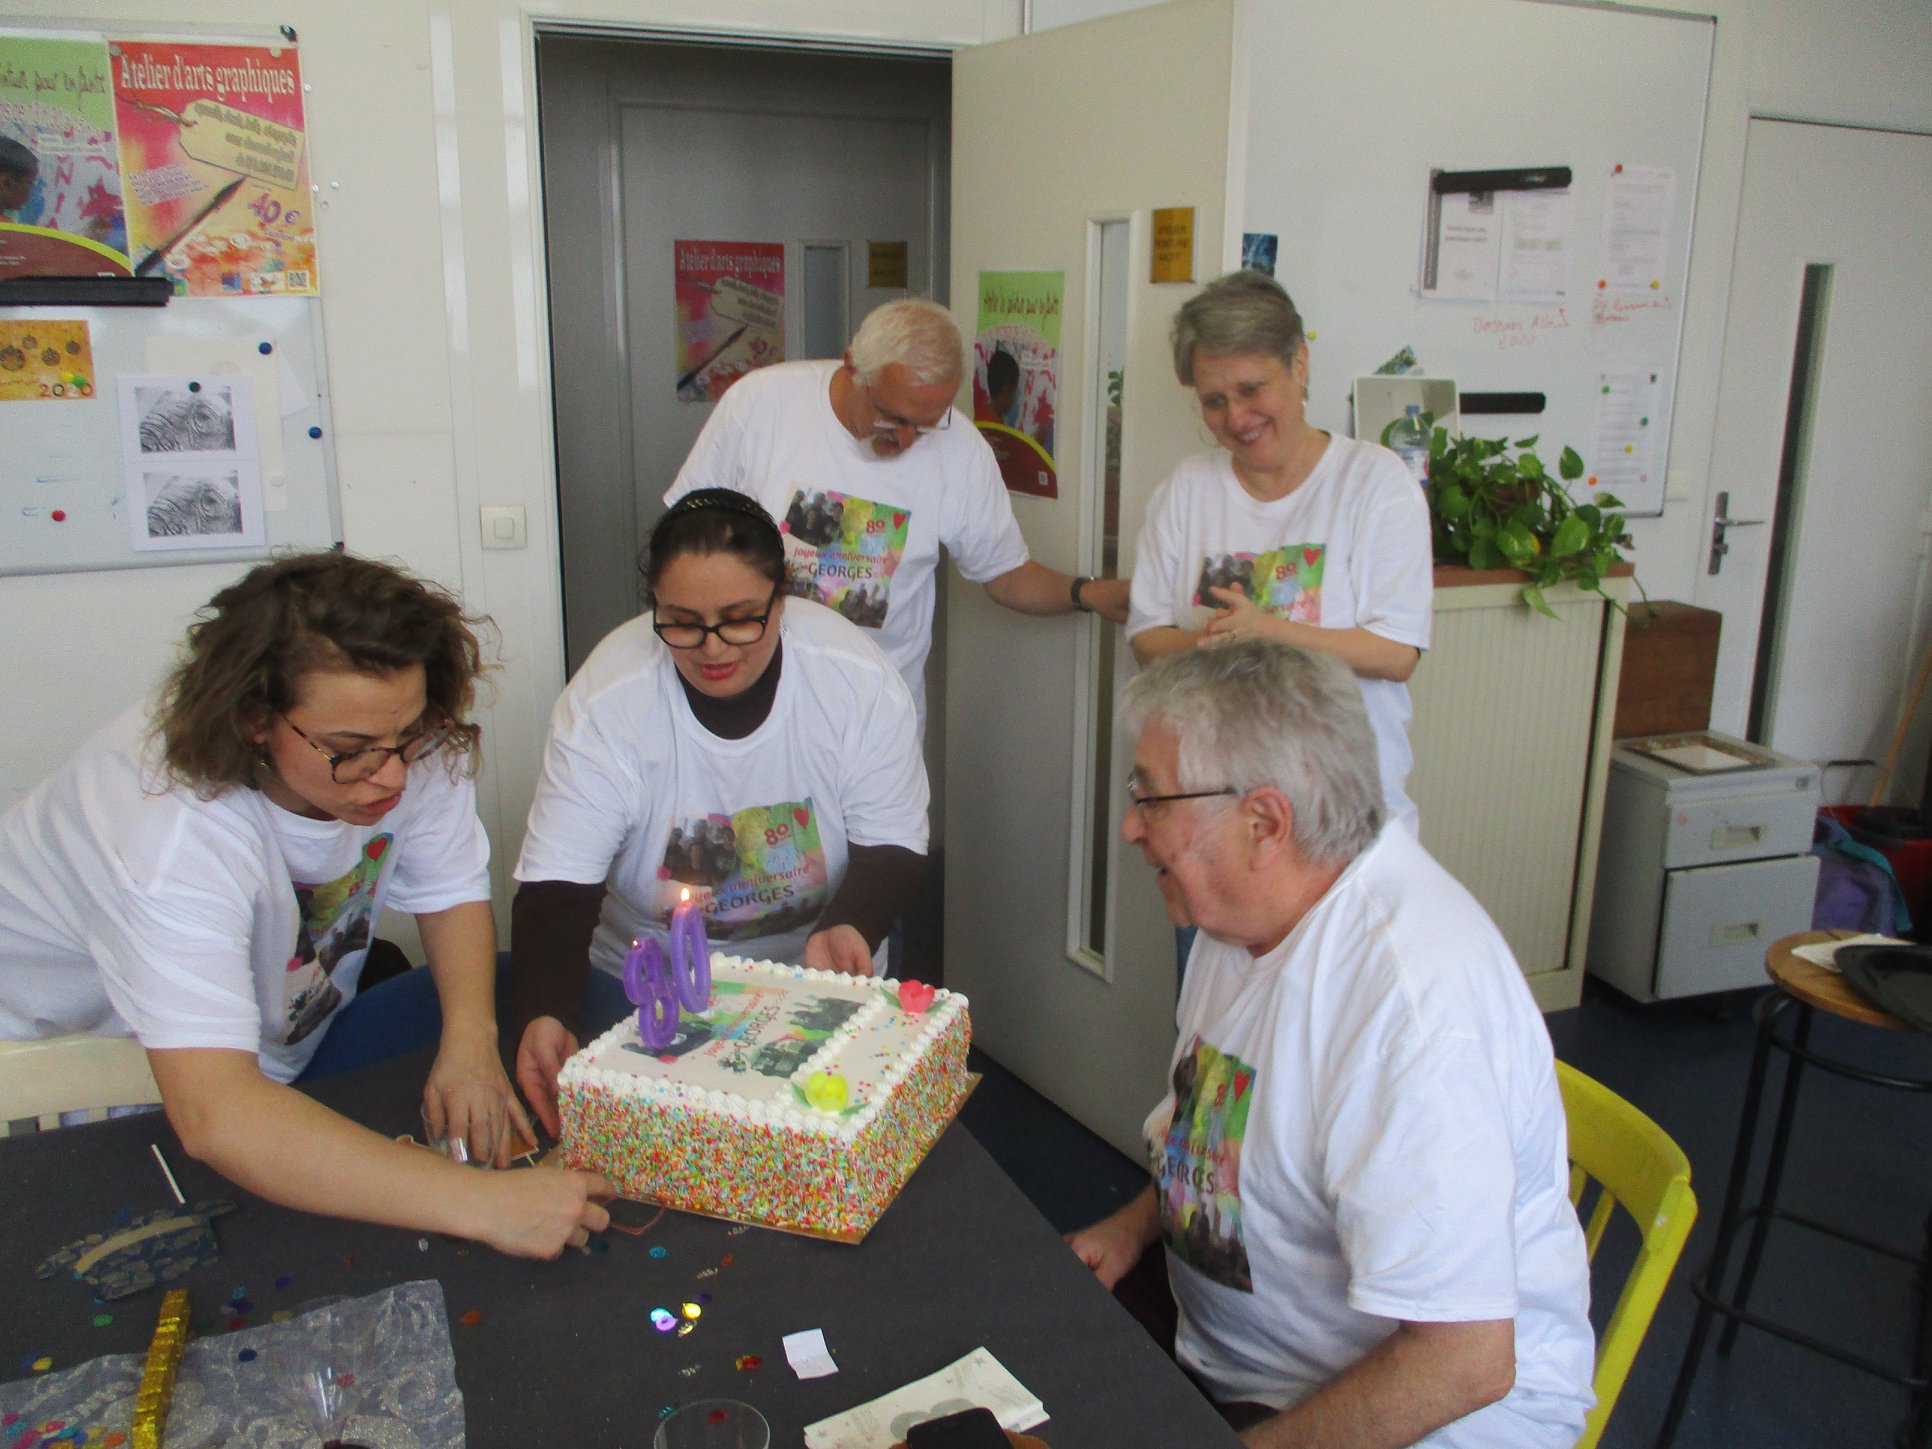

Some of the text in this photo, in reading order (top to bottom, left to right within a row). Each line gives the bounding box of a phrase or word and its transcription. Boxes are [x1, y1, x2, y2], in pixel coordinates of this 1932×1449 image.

[121, 53, 295, 103] Atelier d'arts graphiques
[809, 562, 873, 581] GEORGES
[765, 824, 789, 846] 80
[729, 864, 810, 892] anniversaire
[705, 885, 795, 916] GEORGES
